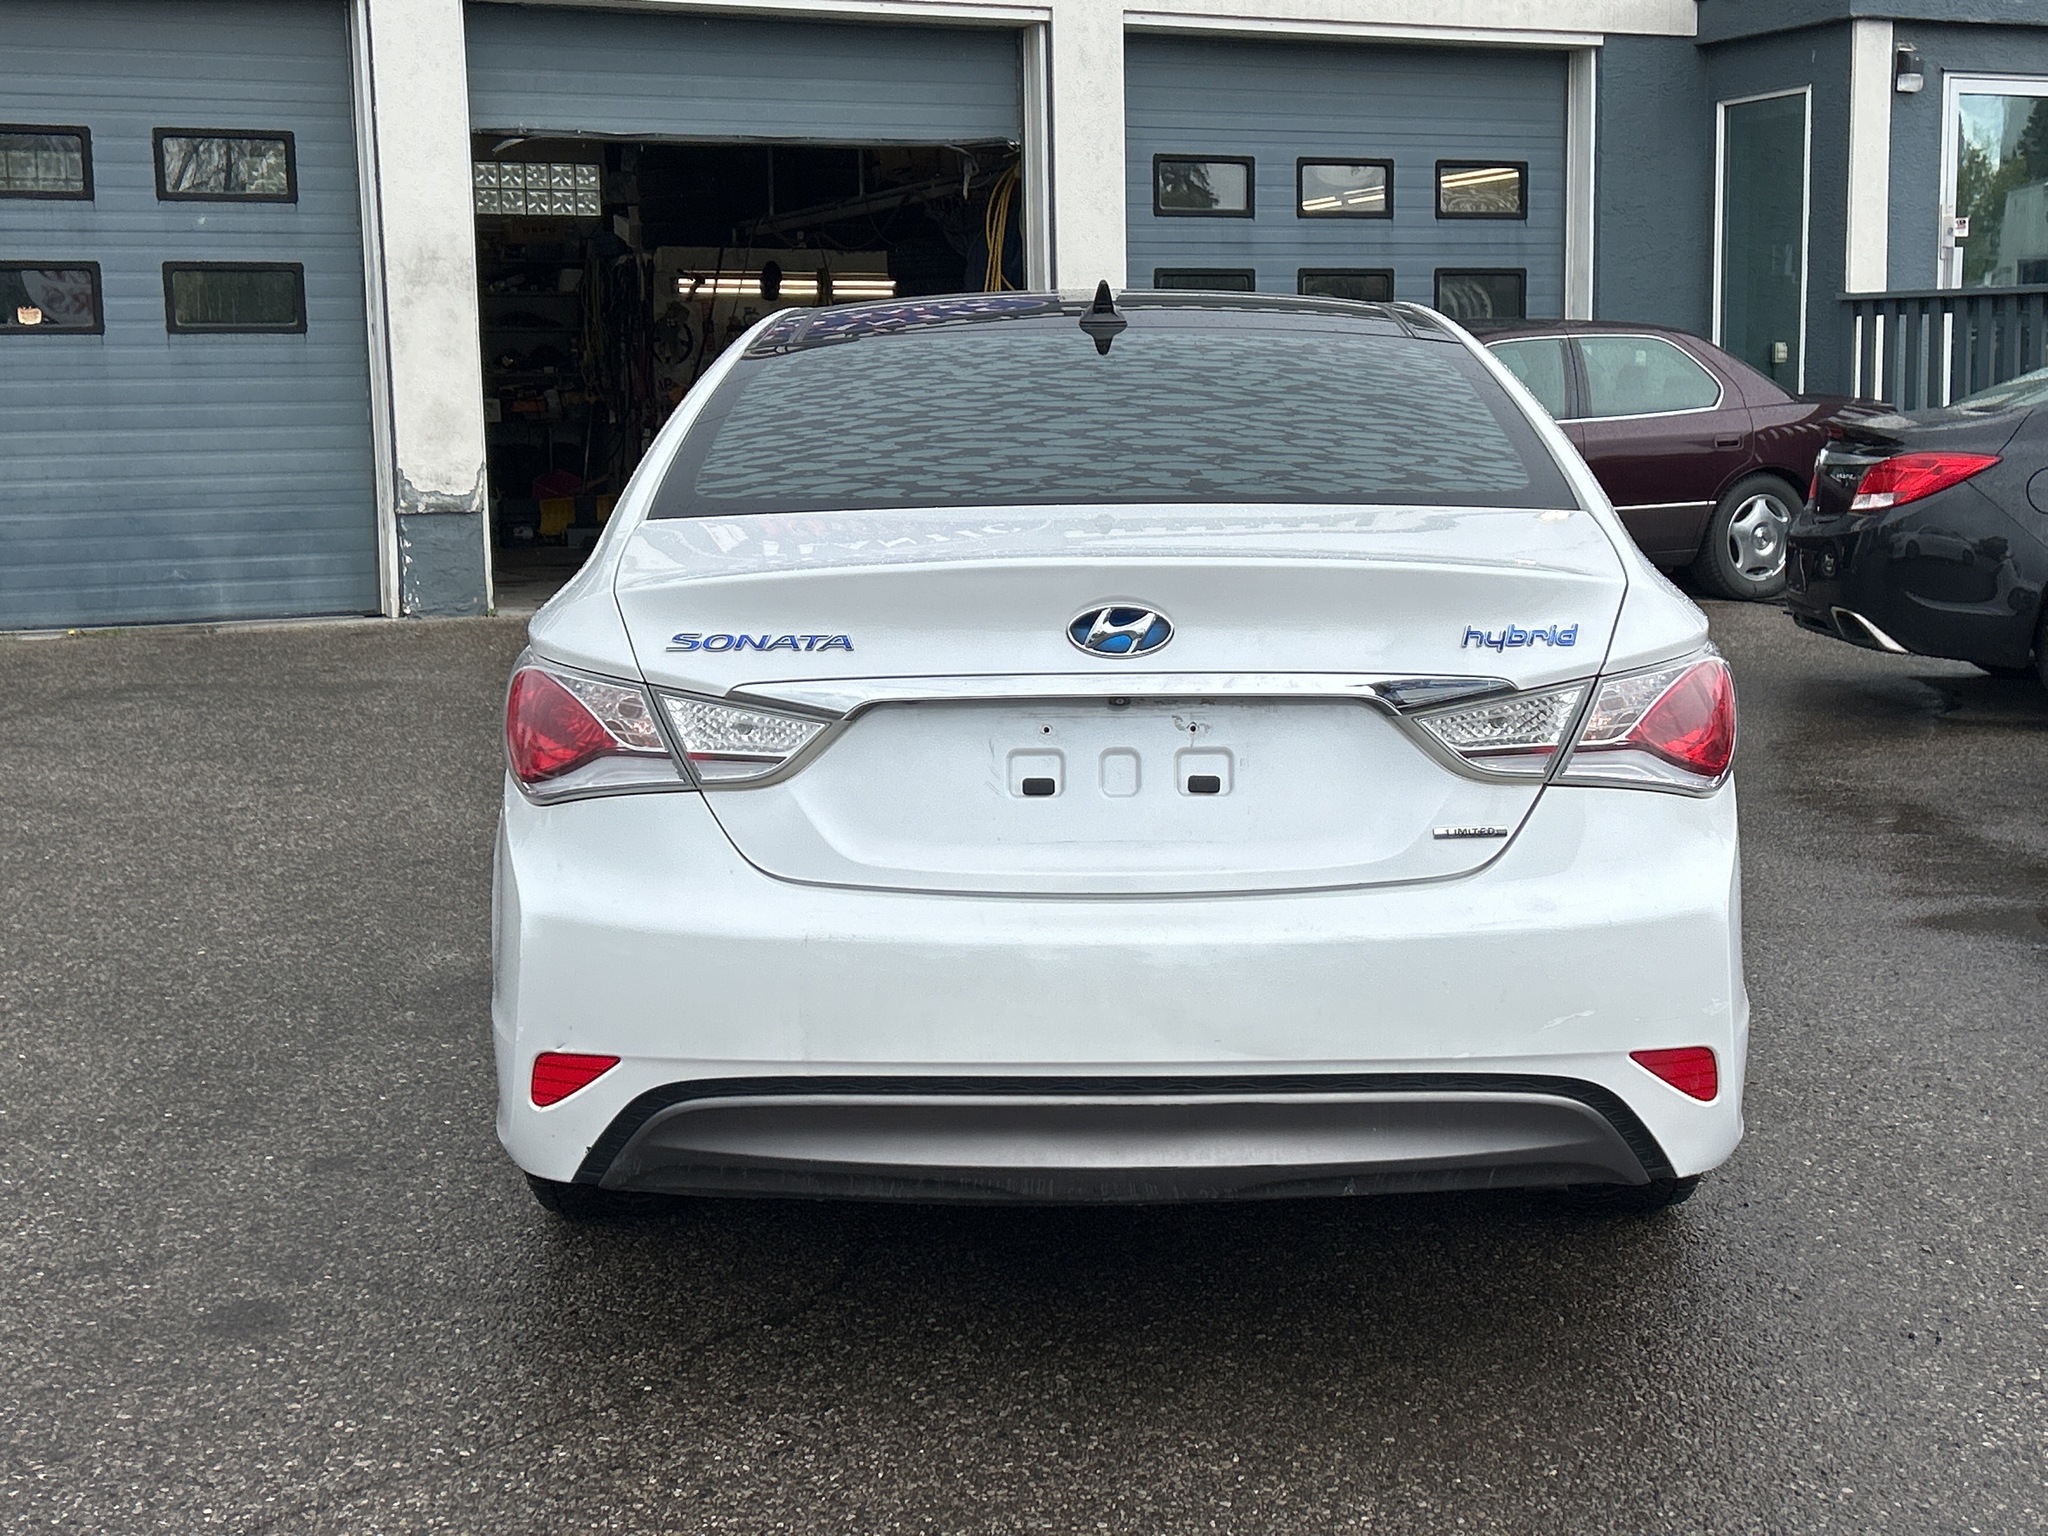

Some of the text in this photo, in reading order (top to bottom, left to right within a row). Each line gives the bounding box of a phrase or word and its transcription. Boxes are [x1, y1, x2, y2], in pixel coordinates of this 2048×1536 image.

[666, 633, 854, 652] SONATA
[1461, 623, 1579, 653] hybrid
[1446, 827, 1495, 836] LIMITED
